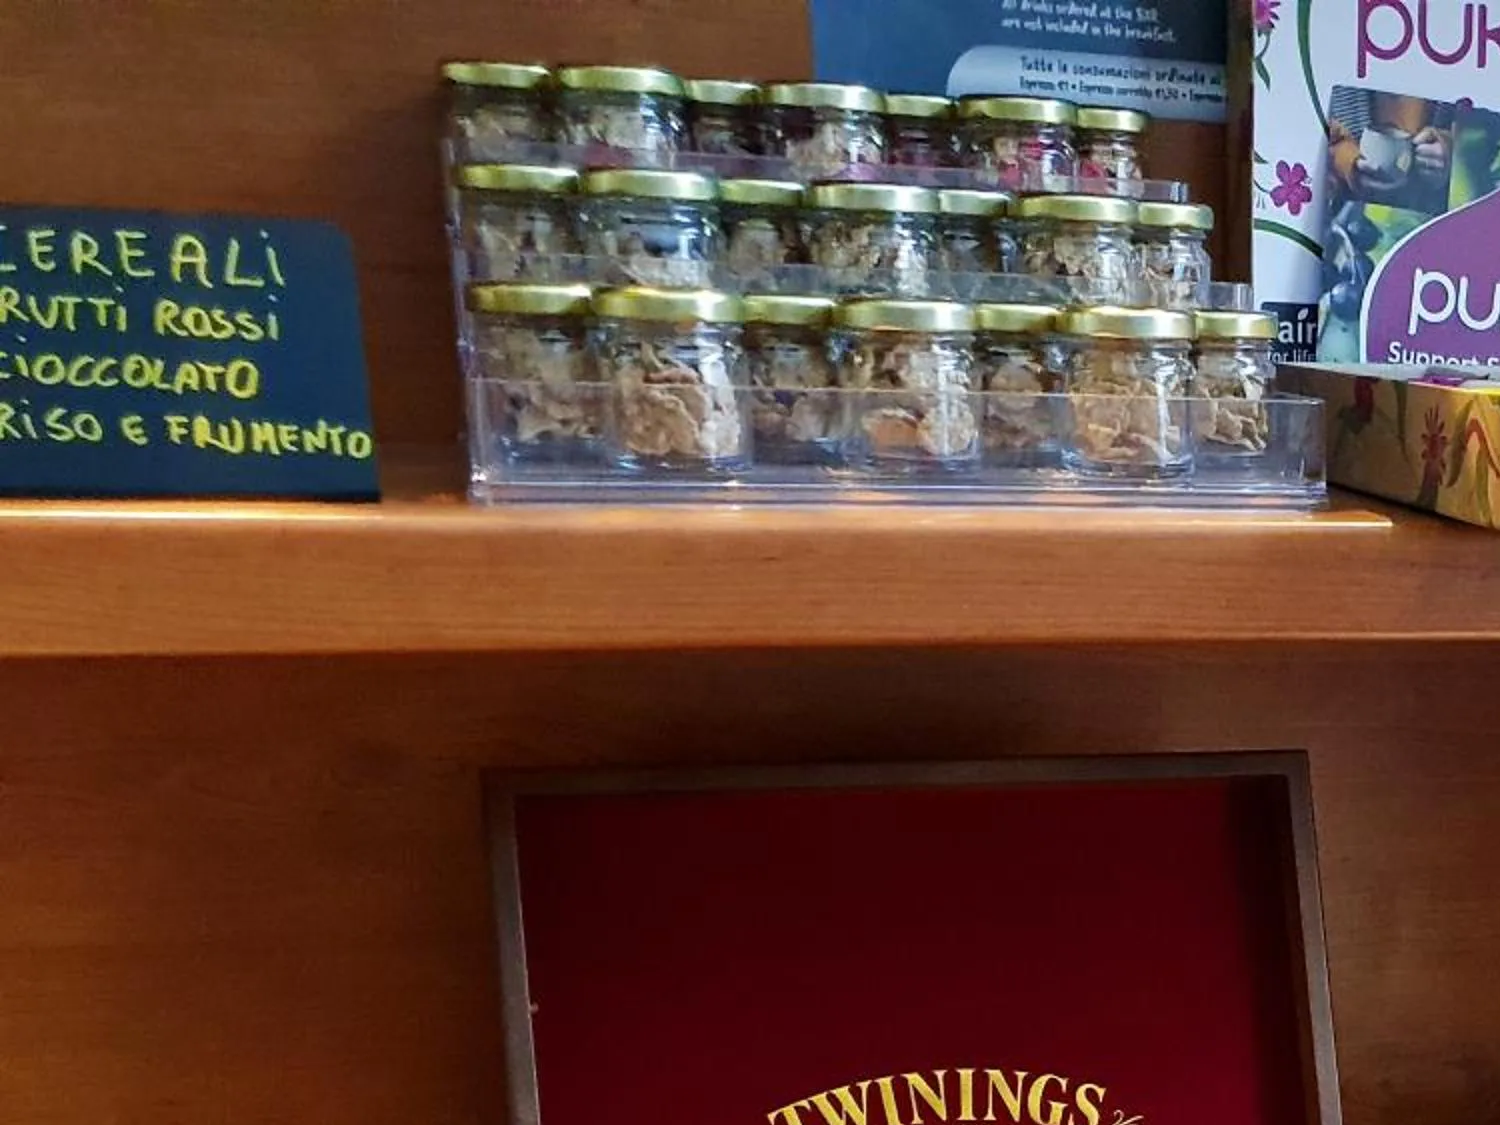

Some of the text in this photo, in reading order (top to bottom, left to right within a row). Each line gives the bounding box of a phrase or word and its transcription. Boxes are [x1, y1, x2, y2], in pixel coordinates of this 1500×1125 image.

[1278, 308, 1317, 344] air
[121, 415, 149, 446] E
[164, 414, 373, 461] FRUMENTO
